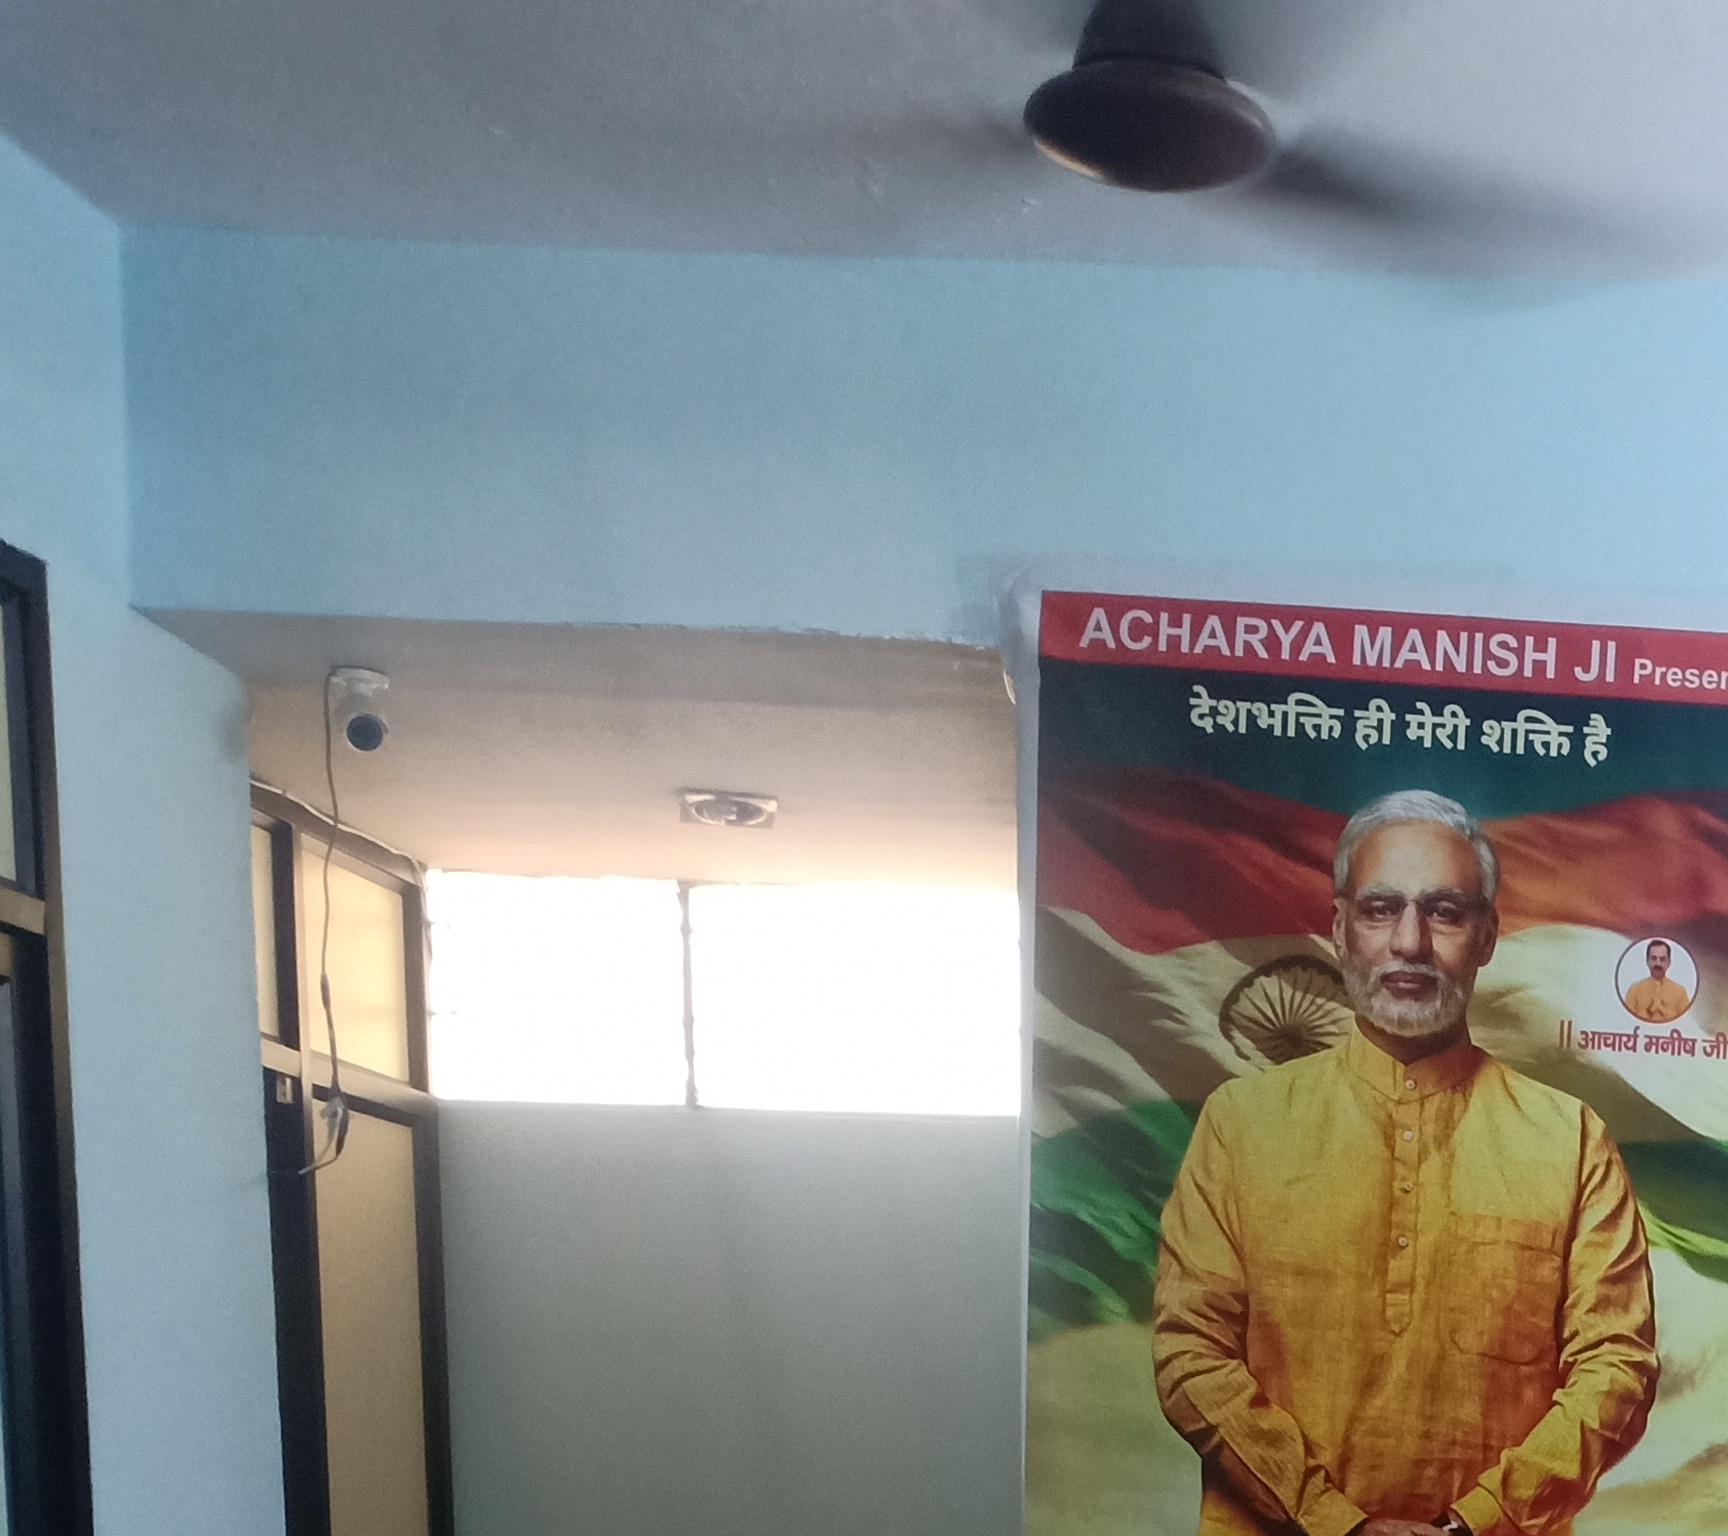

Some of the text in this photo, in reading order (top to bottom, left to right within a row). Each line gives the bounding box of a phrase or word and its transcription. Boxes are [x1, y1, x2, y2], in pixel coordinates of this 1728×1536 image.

[1079, 606, 1336, 664] ACHARYA
[1352, 624, 1557, 679] MANISH
[1574, 640, 1617, 683] JI
[1189, 685, 1611, 768] देशभक्ति ही मेरी शक्ति है
[1577, 1026, 1640, 1053] आचार्य
[1643, 1028, 1697, 1057] मनीष
[1701, 1032, 1728, 1060] जी
